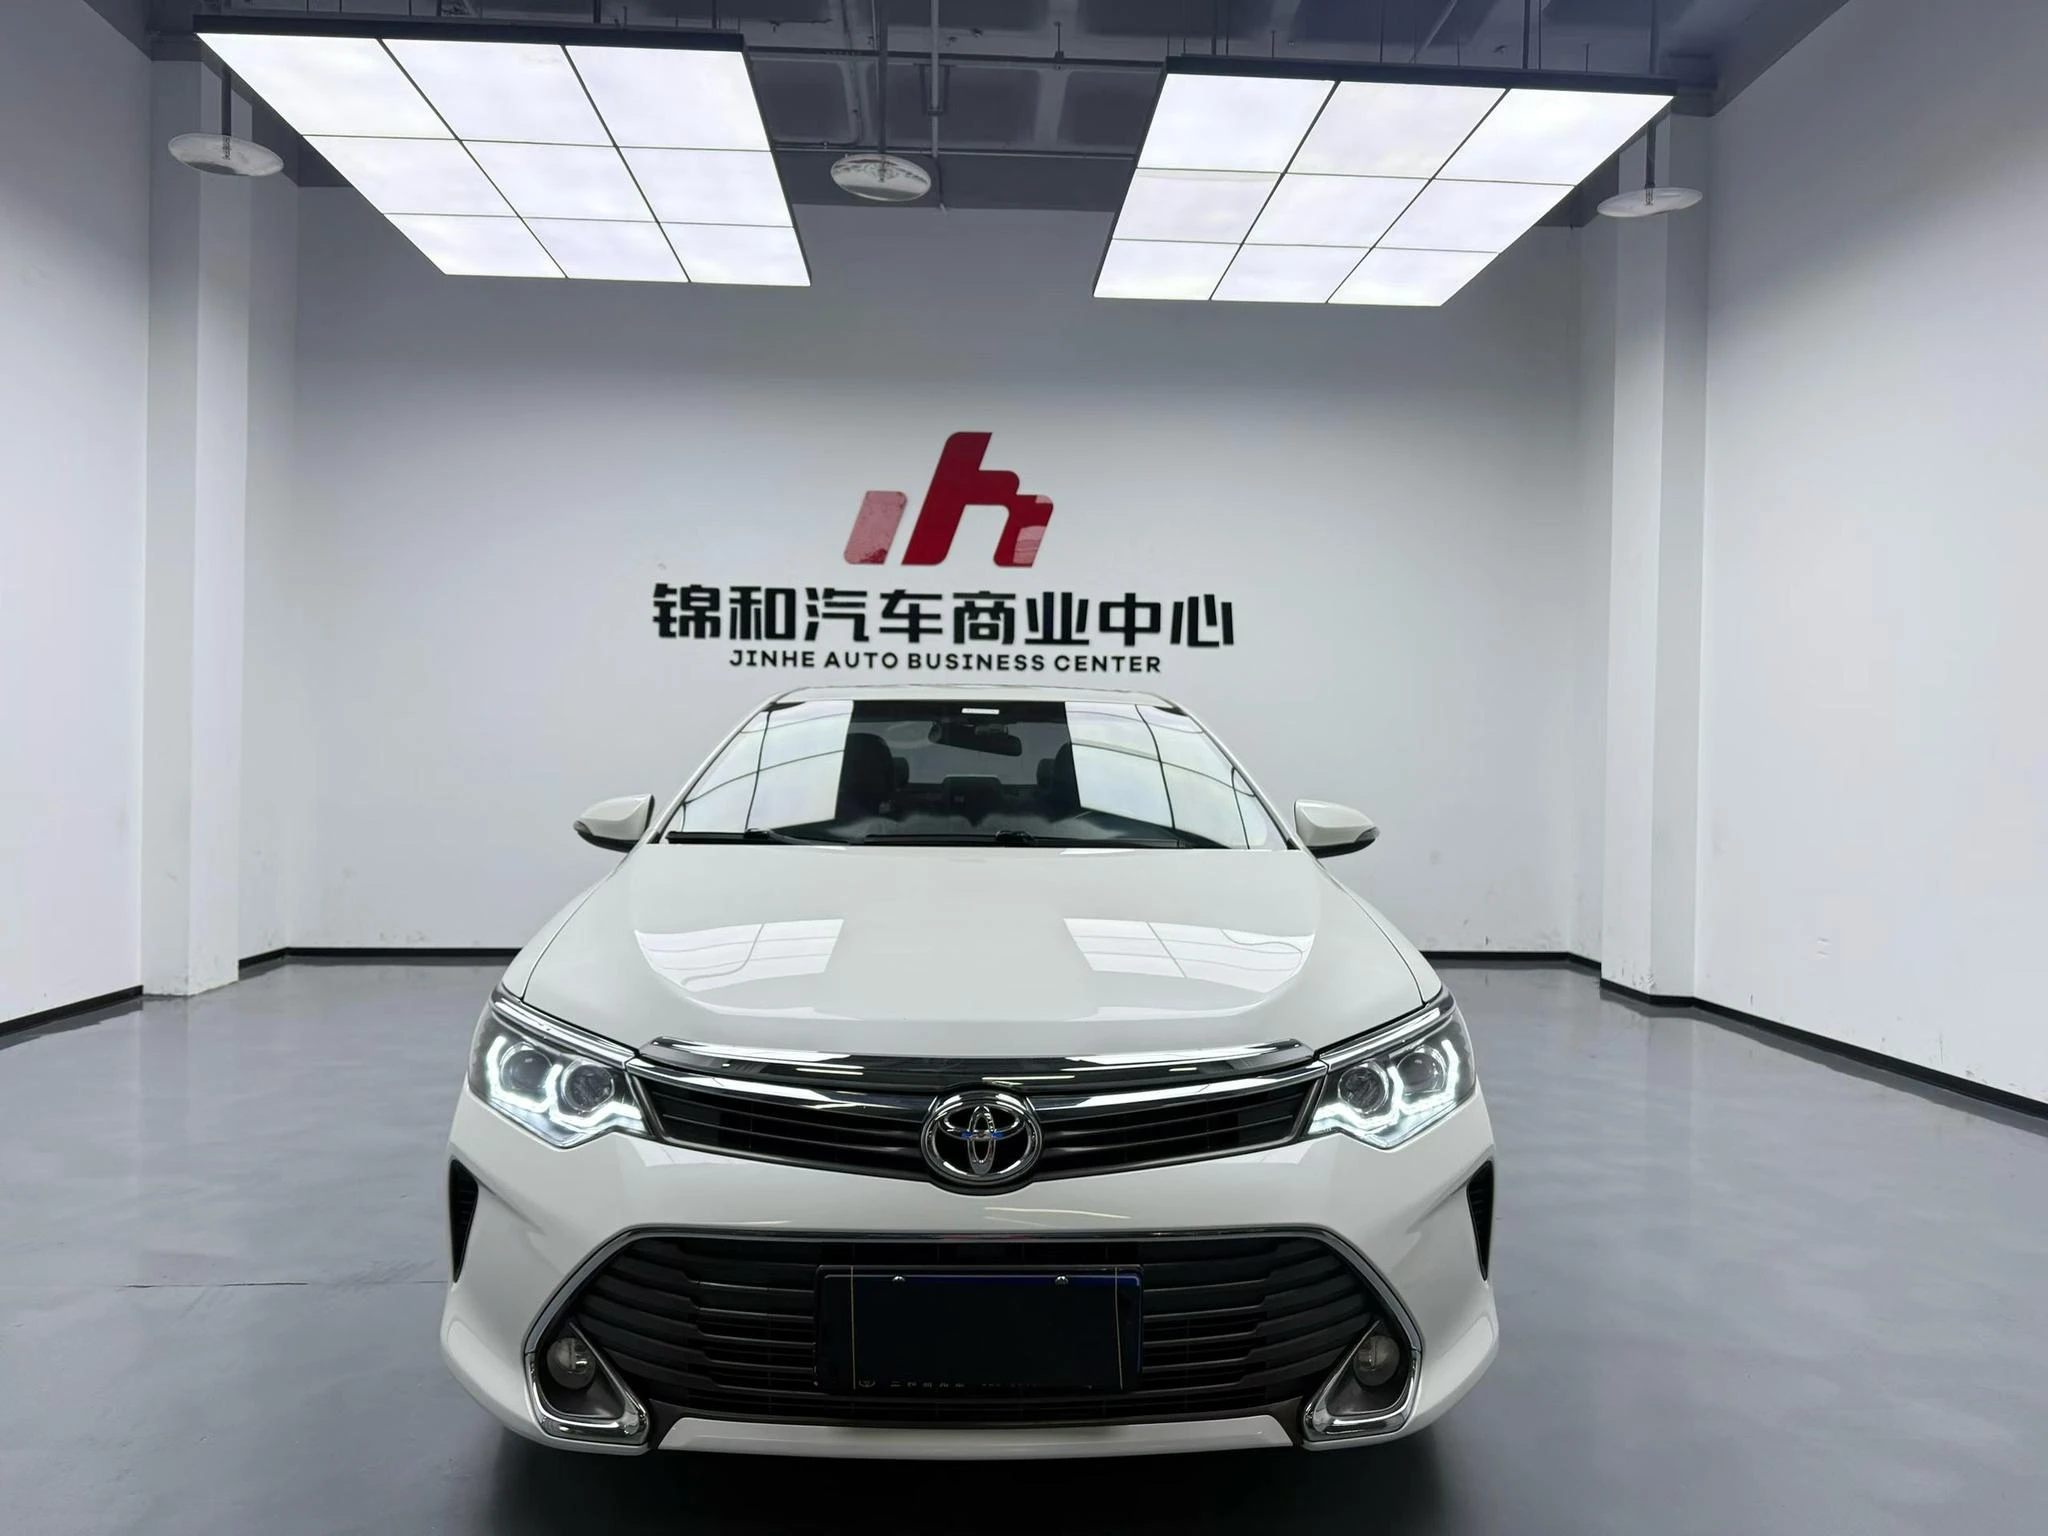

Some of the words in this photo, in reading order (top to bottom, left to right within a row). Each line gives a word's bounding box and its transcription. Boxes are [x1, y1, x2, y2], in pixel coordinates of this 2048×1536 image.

[652, 583, 1235, 648] 锦和汽车商业中心
[729, 649, 815, 669] JINHE
[824, 651, 898, 670] AUTO
[908, 652, 1045, 672] BUSINESS
[1054, 655, 1161, 674] CENTER
